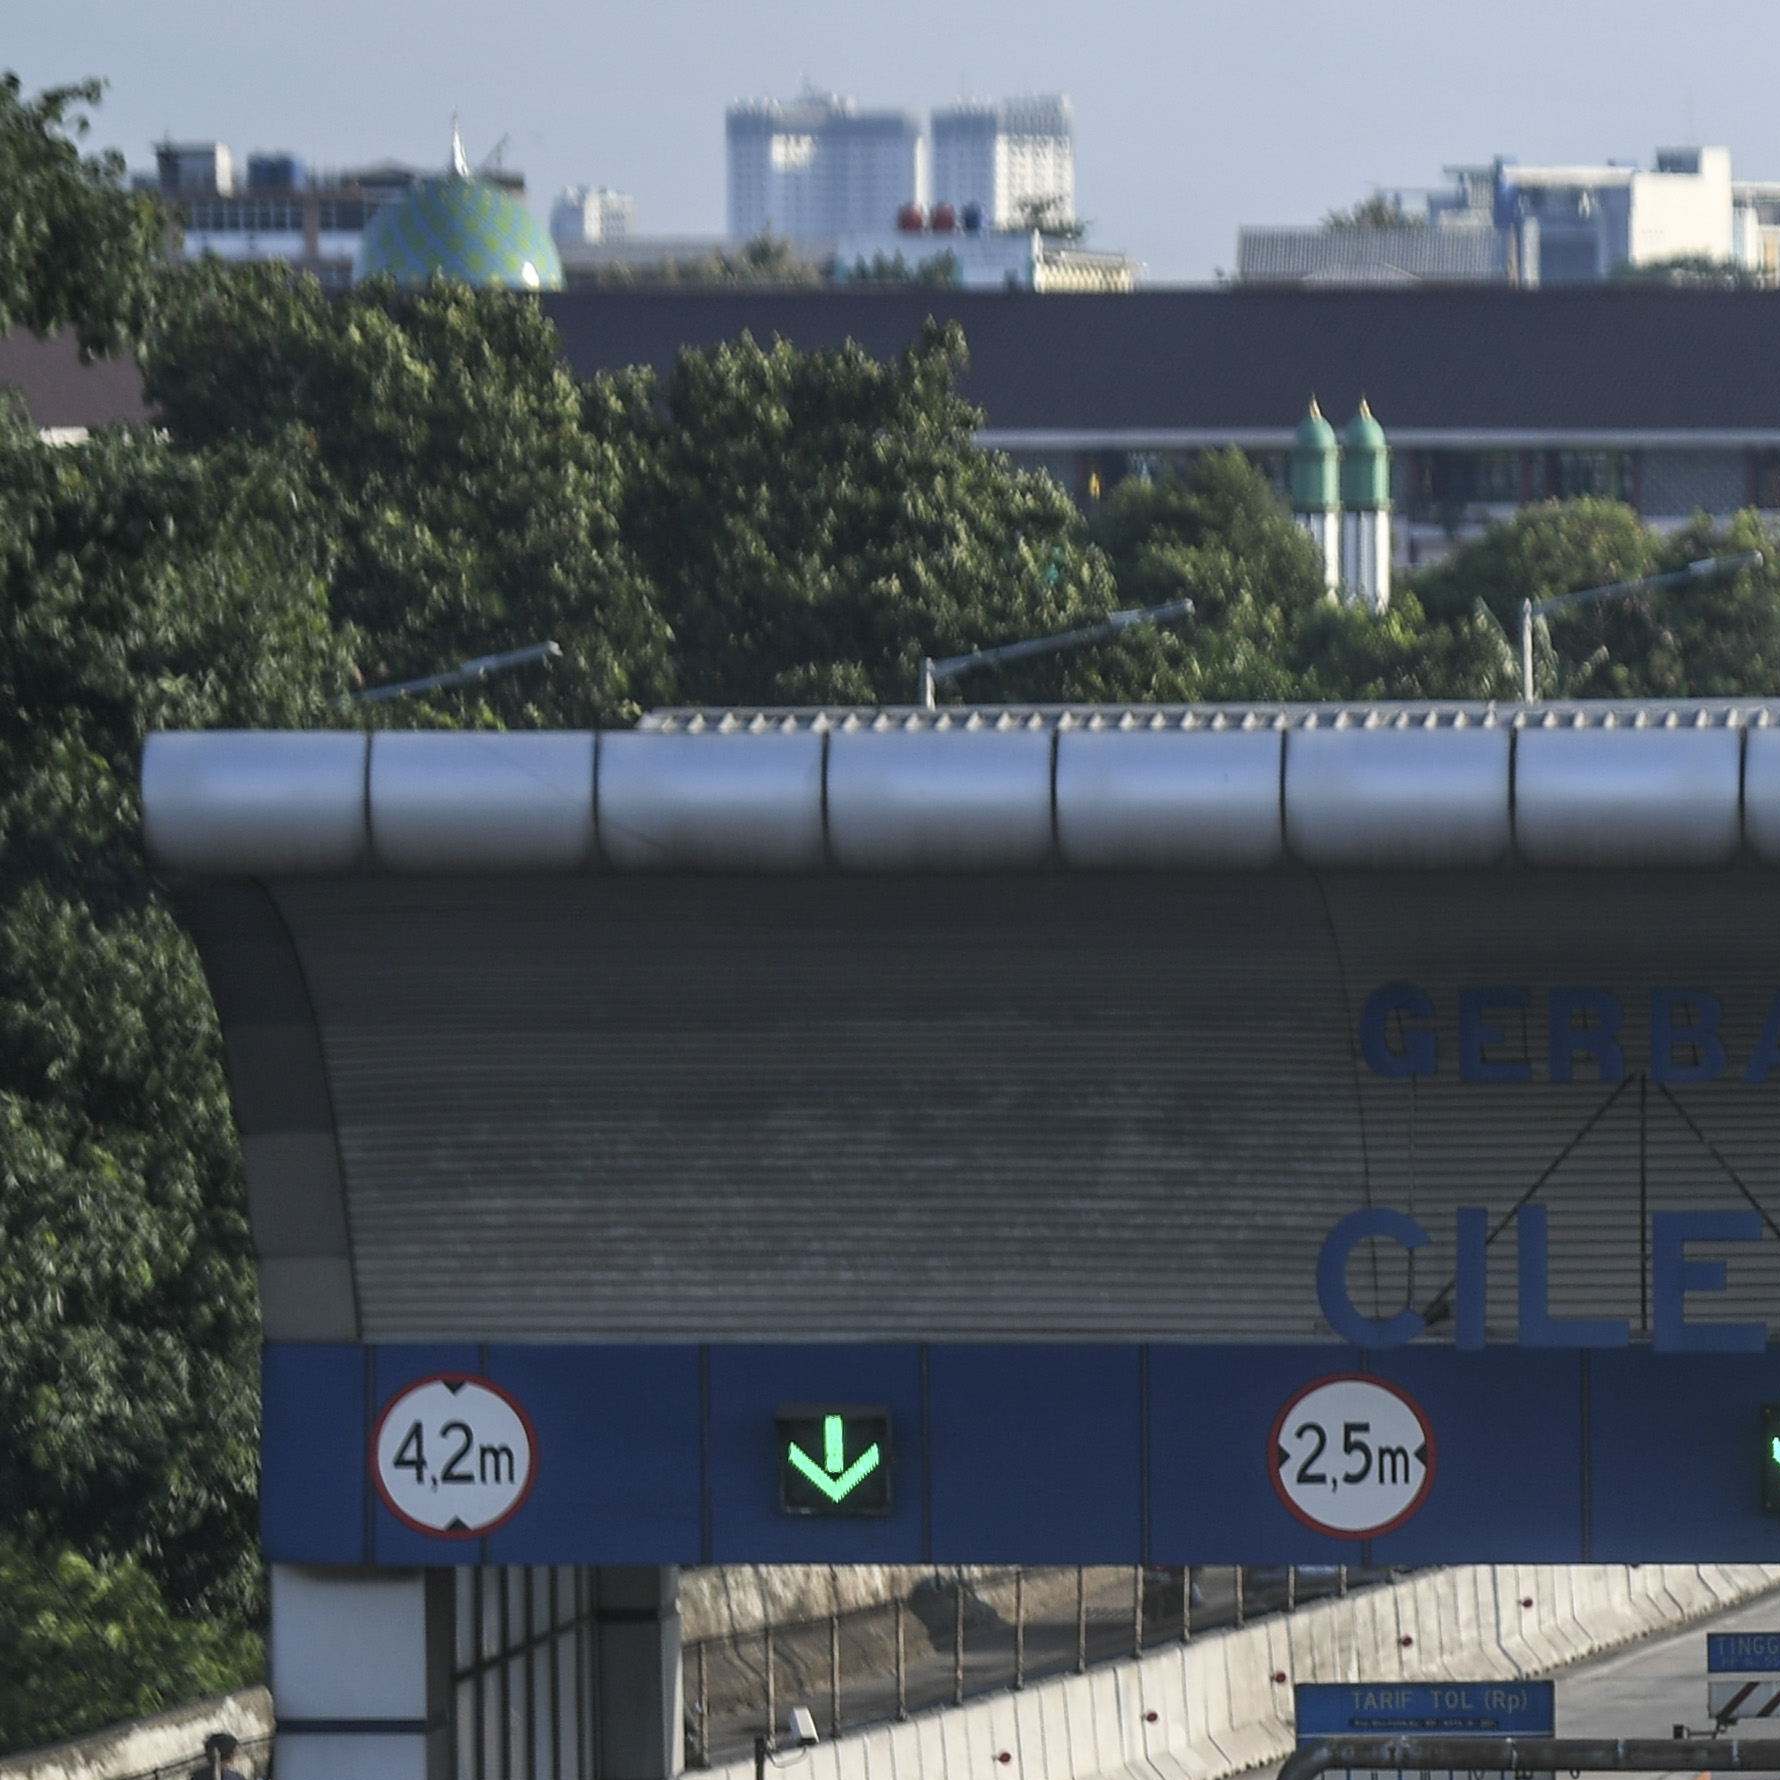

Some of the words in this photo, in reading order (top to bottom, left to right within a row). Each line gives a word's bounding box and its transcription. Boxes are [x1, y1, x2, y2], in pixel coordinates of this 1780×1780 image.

[392, 1421, 517, 1492] 4,2m
[1295, 1421, 1411, 1491] 2,5m
[1350, 1691, 1413, 1711] TARIF
[1428, 1690, 1474, 1710] TOL
[1484, 1689, 1528, 1714] (Rp)
